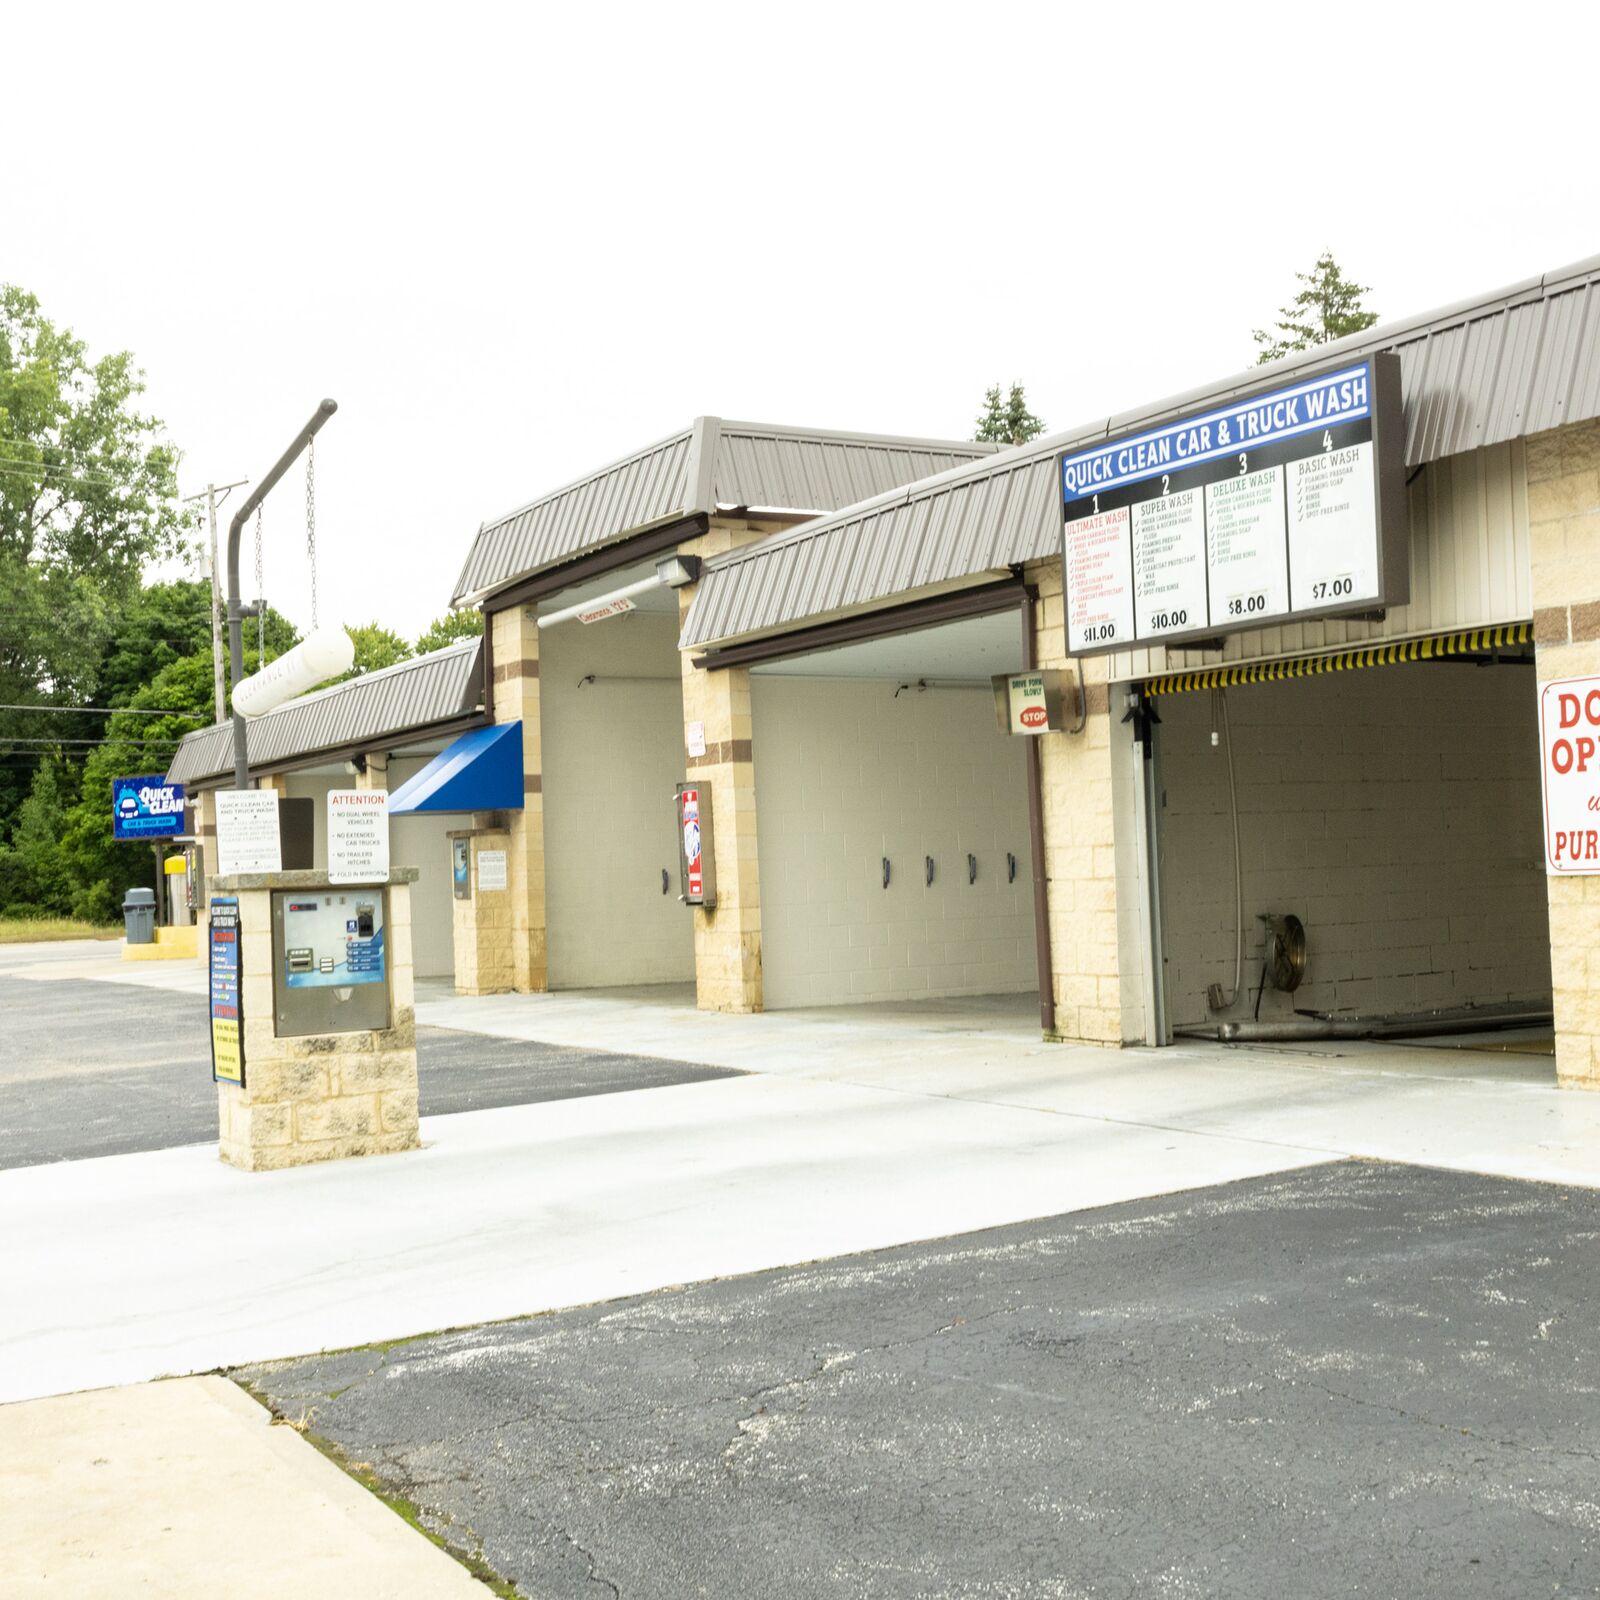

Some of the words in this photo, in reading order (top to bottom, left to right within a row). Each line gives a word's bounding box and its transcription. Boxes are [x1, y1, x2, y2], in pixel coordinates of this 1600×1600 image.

[1065, 456, 1113, 493] QUICK
[1118, 437, 1171, 473] CLEAN
[1179, 425, 1211, 458] CAR
[1217, 419, 1231, 444] &
[1236, 398, 1299, 435] TRUCK
[1305, 376, 1367, 419] WASH
[1322, 429, 1333, 452] 4
[1239, 452, 1248, 475] 3
[1299, 458, 1327, 476] BASIC
[1330, 449, 1359, 468] WASH
[1162, 474, 1170, 496] 2
[1213, 479, 1246, 498] DELUXE
[1249, 471, 1276, 488] WASH
[1092, 494, 1099, 514] 1
[1141, 500, 1166, 517] SUPER
[1168, 494, 1193, 509] WASH
[1067, 517, 1104, 536] ULTIMATE
[1105, 510, 1128, 526] WASH
[1312, 578, 1353, 599] $7.00
[1229, 595, 1265, 614] $8.00
[1152, 610, 1187, 629] $10.00
[1084, 623, 1115, 642] $11.00
[1023, 711, 1047, 723] STOP
[1551, 736, 1600, 774] OP
[139, 786, 174, 807] QUICK
[149, 798, 184, 815] CLEAN
[332, 795, 385, 805] ATTENTION
